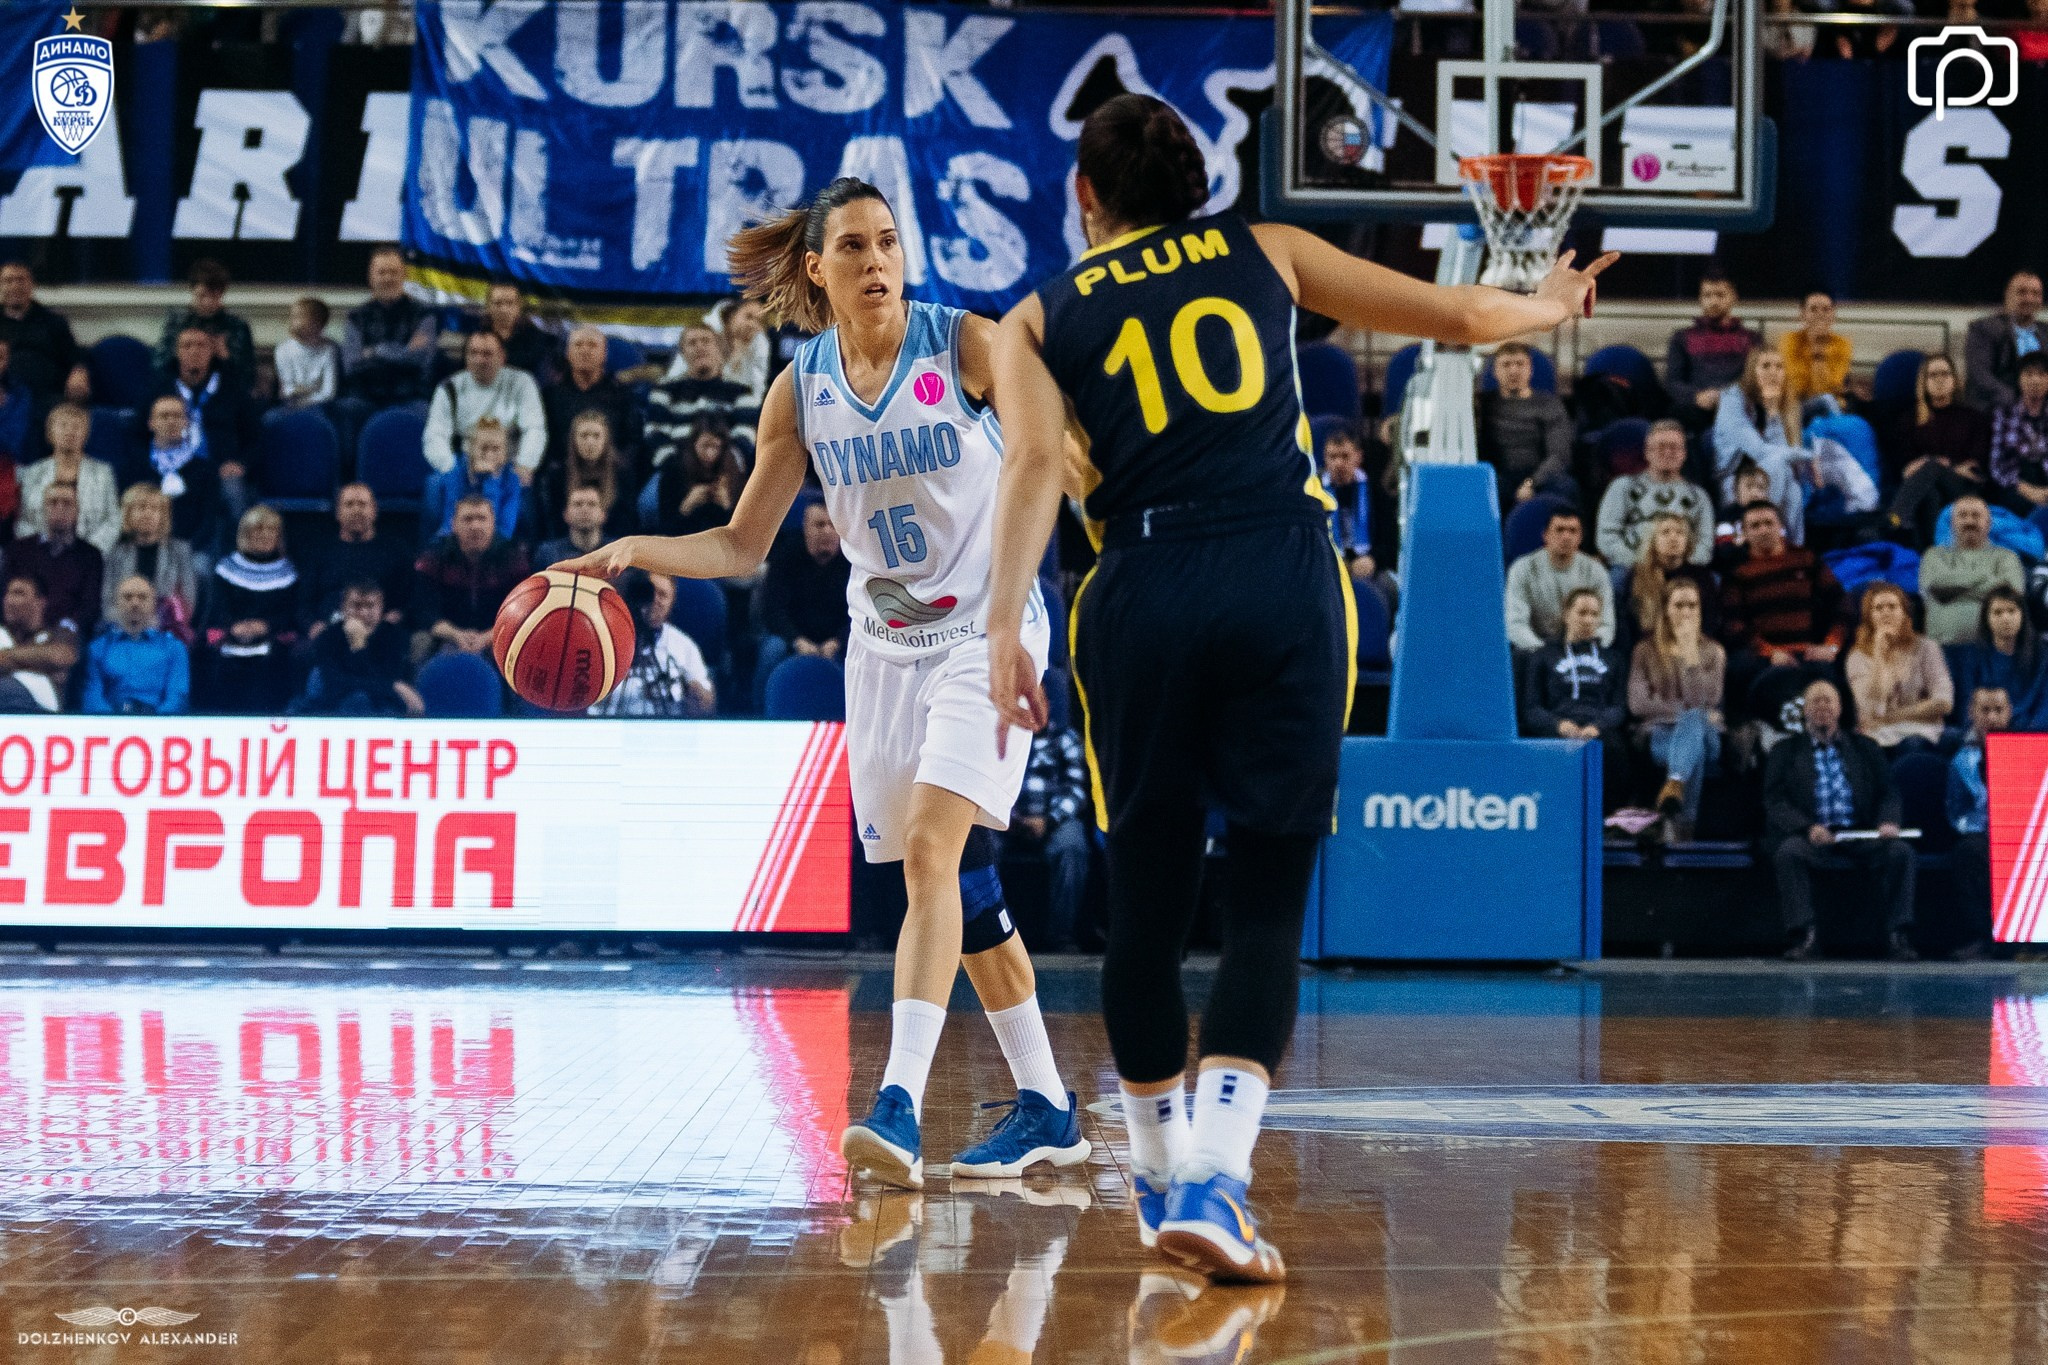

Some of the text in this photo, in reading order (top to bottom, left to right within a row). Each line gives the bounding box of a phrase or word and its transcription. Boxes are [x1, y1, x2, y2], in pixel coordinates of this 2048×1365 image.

[437, 0, 1015, 130] KURSK
[1074, 228, 1231, 296] PLUM
[1103, 296, 1266, 434] 10
[814, 421, 961, 487] DYNAMO
[868, 504, 928, 569] 15
[318, 737, 518, 811] ЦЕНТР
[1363, 786, 1539, 831] molten
